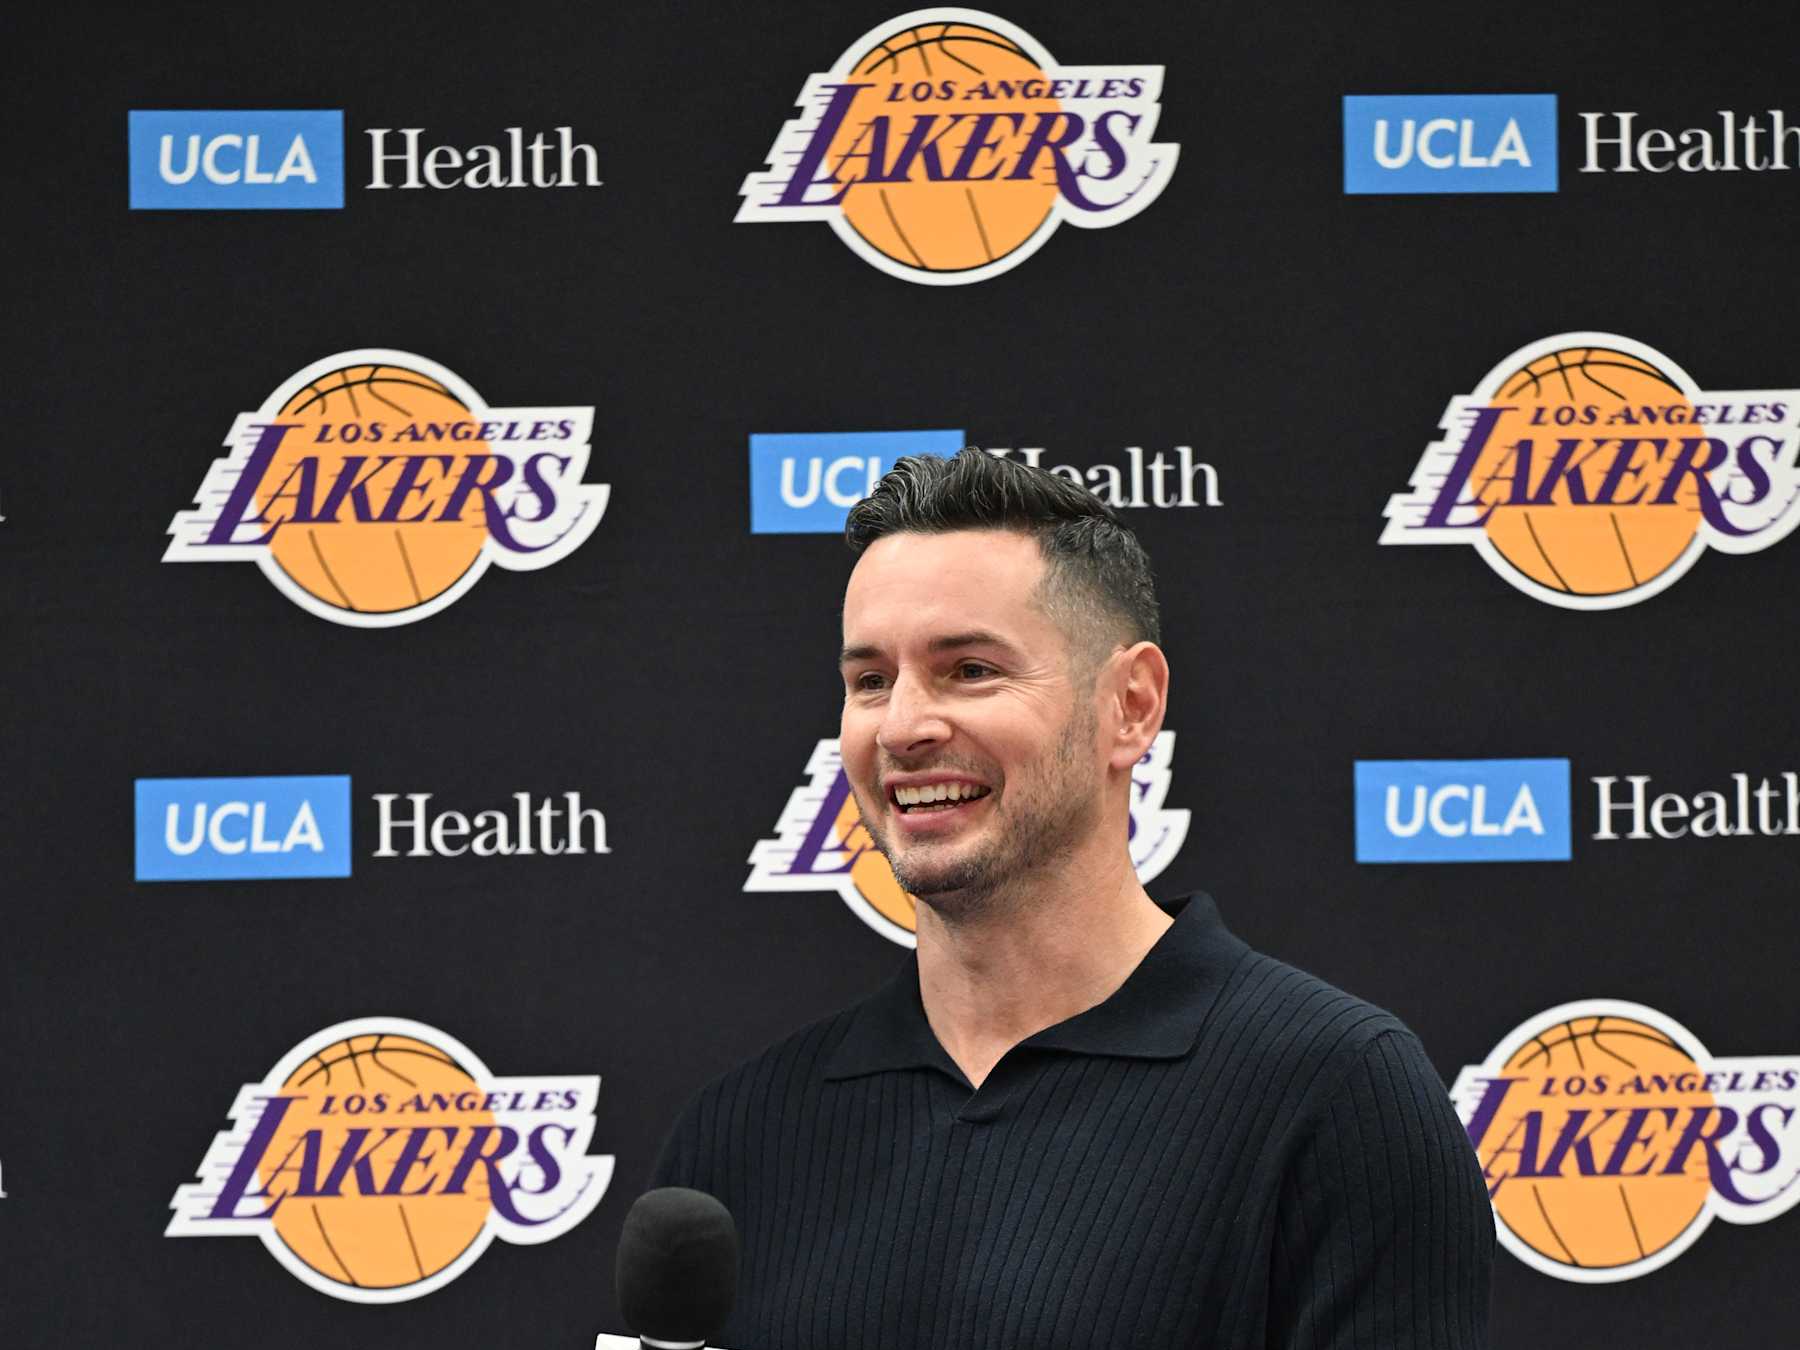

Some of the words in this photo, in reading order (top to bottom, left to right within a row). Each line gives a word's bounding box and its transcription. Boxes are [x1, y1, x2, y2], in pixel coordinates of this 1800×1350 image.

[886, 81, 958, 102] LOS
[963, 77, 1145, 101] ANGELES
[159, 133, 318, 185] UCLA
[364, 127, 603, 189] Health
[771, 83, 1161, 212] LAKERS
[1373, 117, 1532, 170] UCLA
[1579, 109, 1800, 173] Health
[315, 421, 387, 443] LOS
[391, 418, 576, 442] ANGELES
[1531, 405, 1603, 427] LOS
[1608, 402, 1787, 425] ANGELES
[200, 424, 590, 553] LAKERS
[779, 455, 882, 509] UC
[985, 446, 1223, 508] alth
[1418, 406, 1800, 537] LAKERS
[164, 799, 325, 856] UCLA
[372, 791, 611, 857] Health
[1384, 783, 1546, 838] UCLA
[321, 1092, 391, 1115] LOS
[398, 1089, 581, 1113] ANGELES
[1540, 1075, 1610, 1097] LOS
[1616, 1070, 1798, 1095] ANGELES
[201, 1096, 595, 1226] LAKERS
[1465, 1078, 1800, 1206] LAKERS
